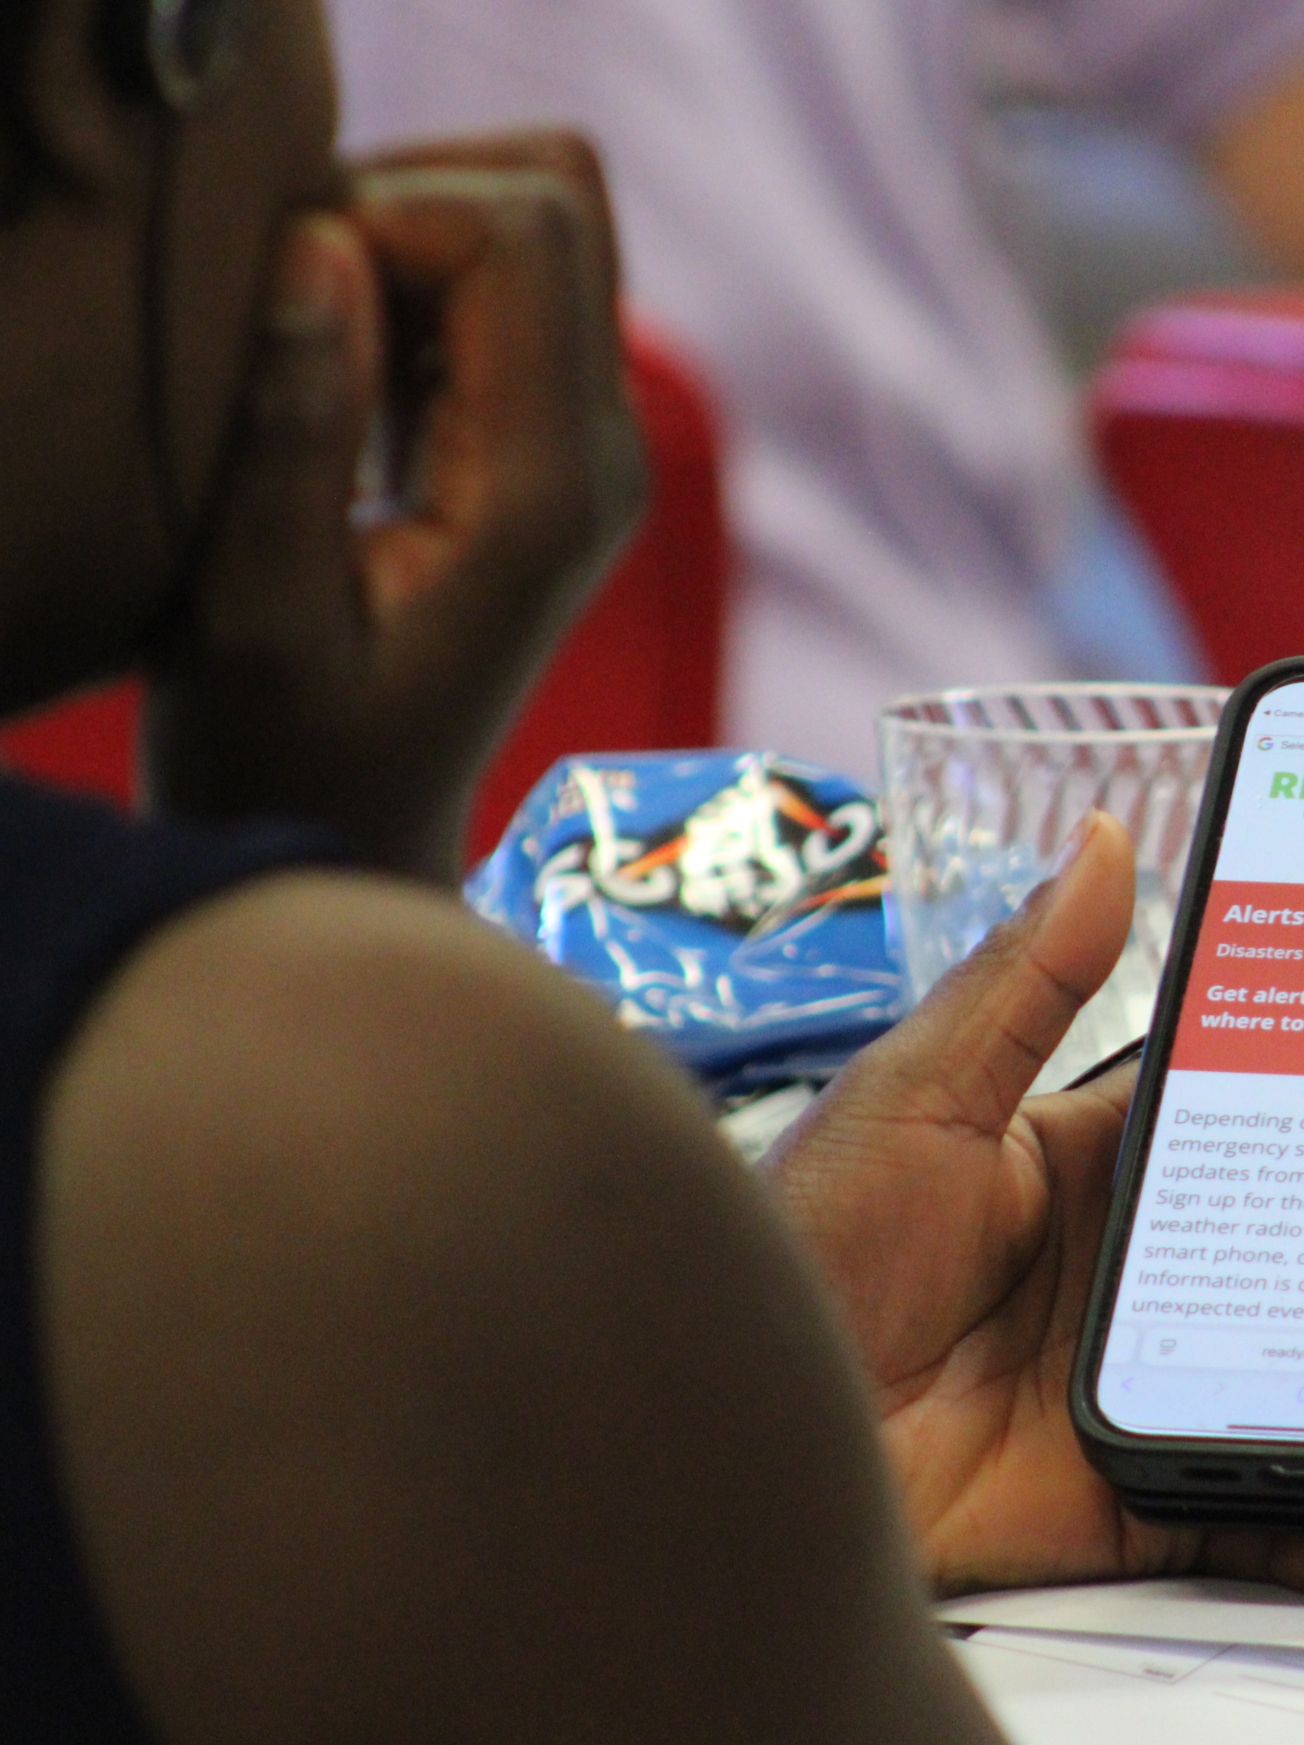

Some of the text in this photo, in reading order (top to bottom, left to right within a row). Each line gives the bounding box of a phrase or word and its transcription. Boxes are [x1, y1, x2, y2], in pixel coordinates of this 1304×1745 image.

[1223, 904, 1304, 926] Alerts
[1216, 943, 1303, 960] Disasters
[1206, 984, 1247, 1003] Get
[1200, 1012, 1274, 1030] where
[1281, 1016, 1304, 1032] to
[1174, 1108, 1293, 1133] Depending
[1168, 1138, 1289, 1159] emergency
[1162, 1163, 1250, 1184] updates
[1156, 1189, 1200, 1209] Sign
[1207, 1194, 1236, 1210] up
[1243, 1191, 1275, 1209] for
[1150, 1216, 1239, 1236] weather
[1246, 1219, 1302, 1238] radio
[1144, 1244, 1208, 1262] smart
[1213, 1246, 1288, 1267] phone,
[1138, 1269, 1267, 1290] Information
[1274, 1275, 1291, 1291] is
[1131, 1297, 1260, 1319] unexpected
